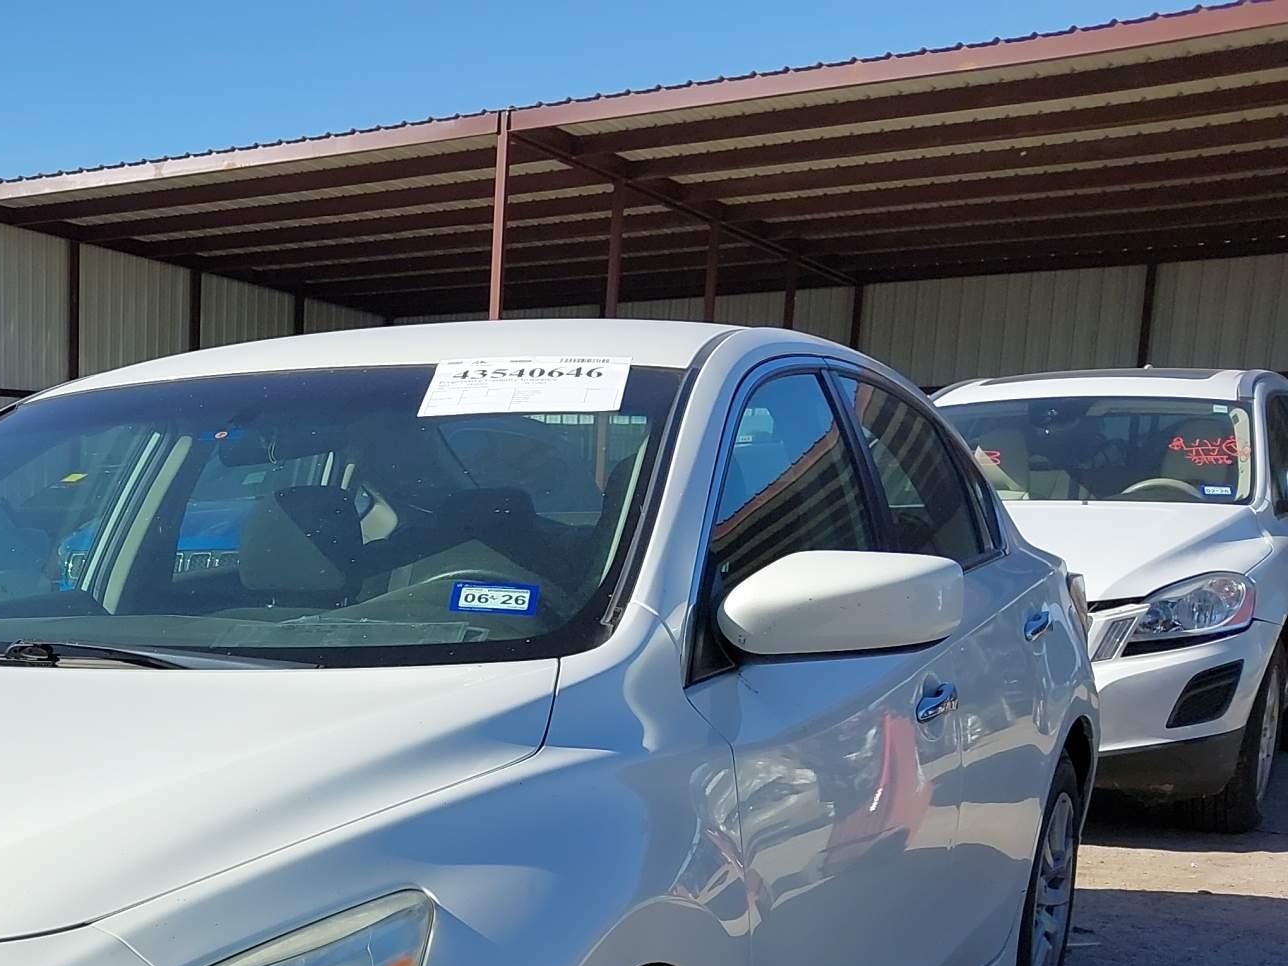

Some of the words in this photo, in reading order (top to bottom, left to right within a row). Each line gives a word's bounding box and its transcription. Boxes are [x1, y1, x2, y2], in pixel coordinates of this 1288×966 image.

[452, 366, 604, 380] 43540646
[463, 593, 489, 604] 06
[500, 595, 527, 605] 26
